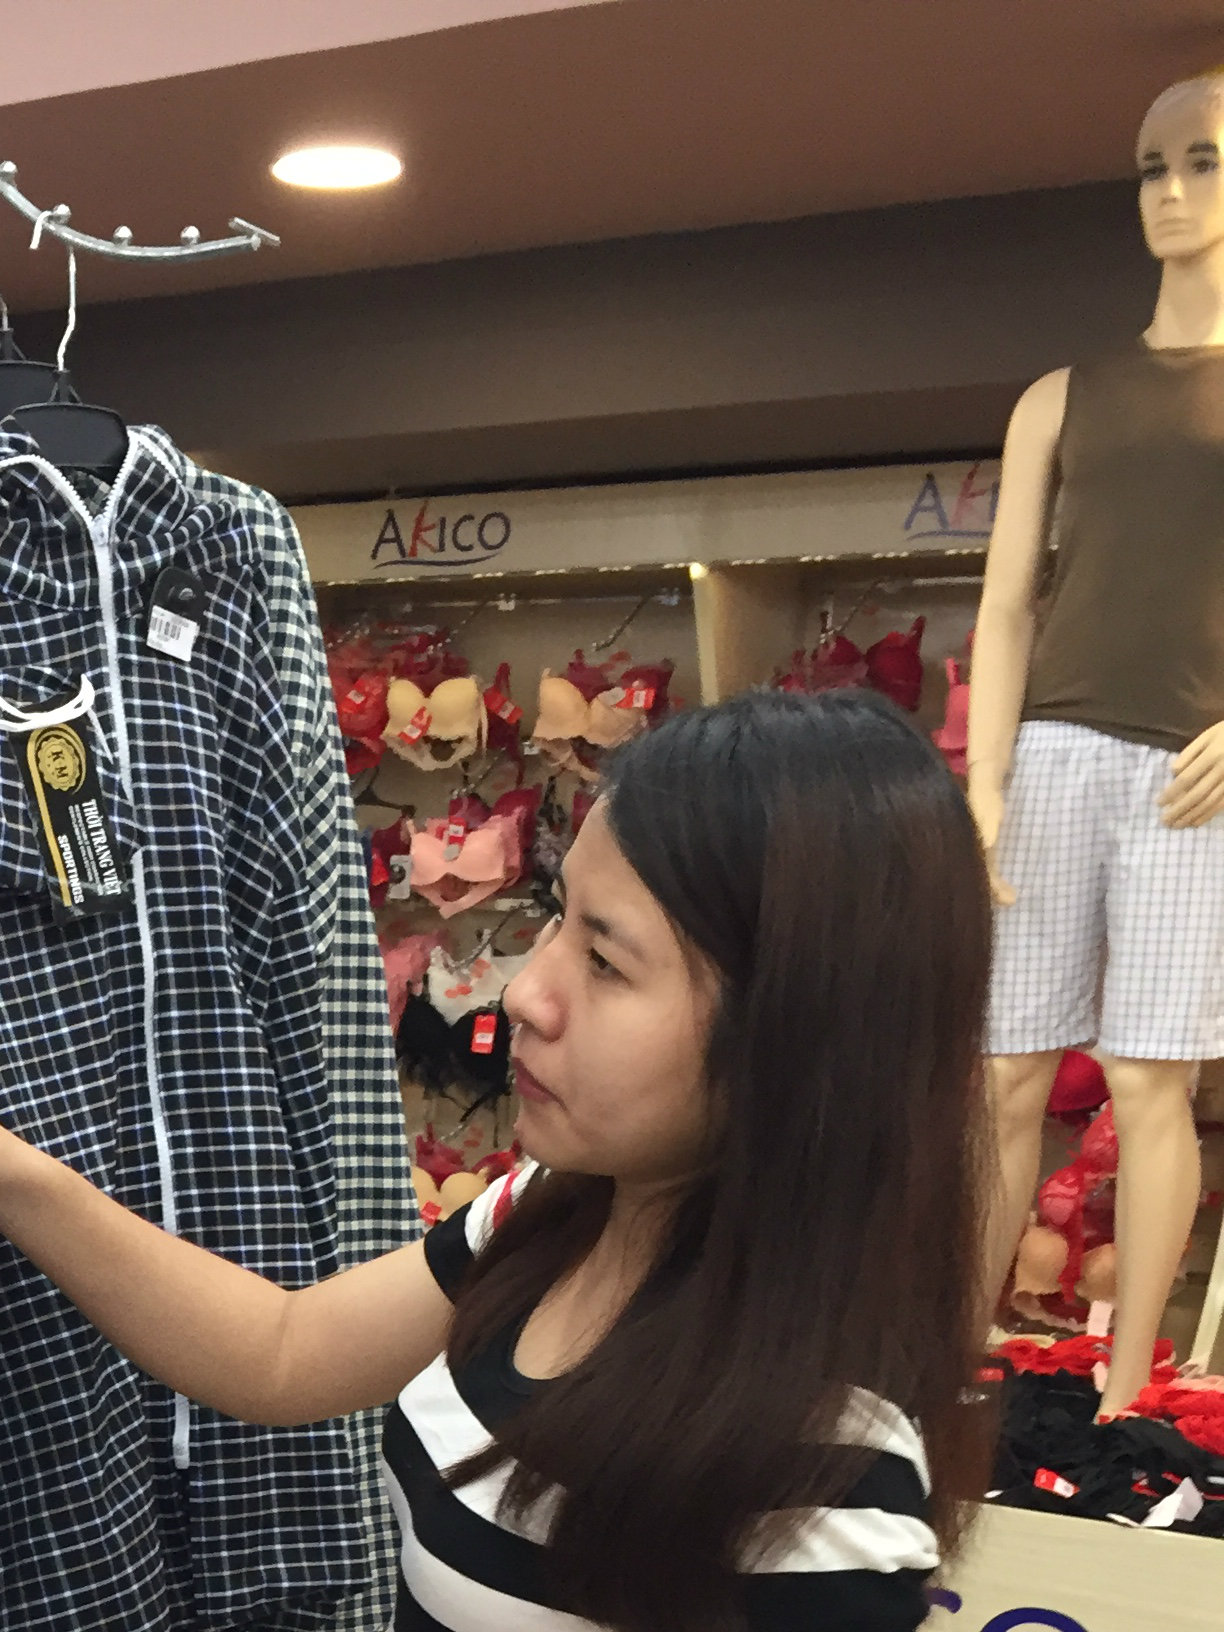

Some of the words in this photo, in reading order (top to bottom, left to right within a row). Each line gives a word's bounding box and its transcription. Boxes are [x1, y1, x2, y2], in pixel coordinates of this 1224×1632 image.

[371, 500, 511, 559] AKICO
[58, 834, 84, 904] SPORTINGS
[90, 828, 114, 868] TRANG
